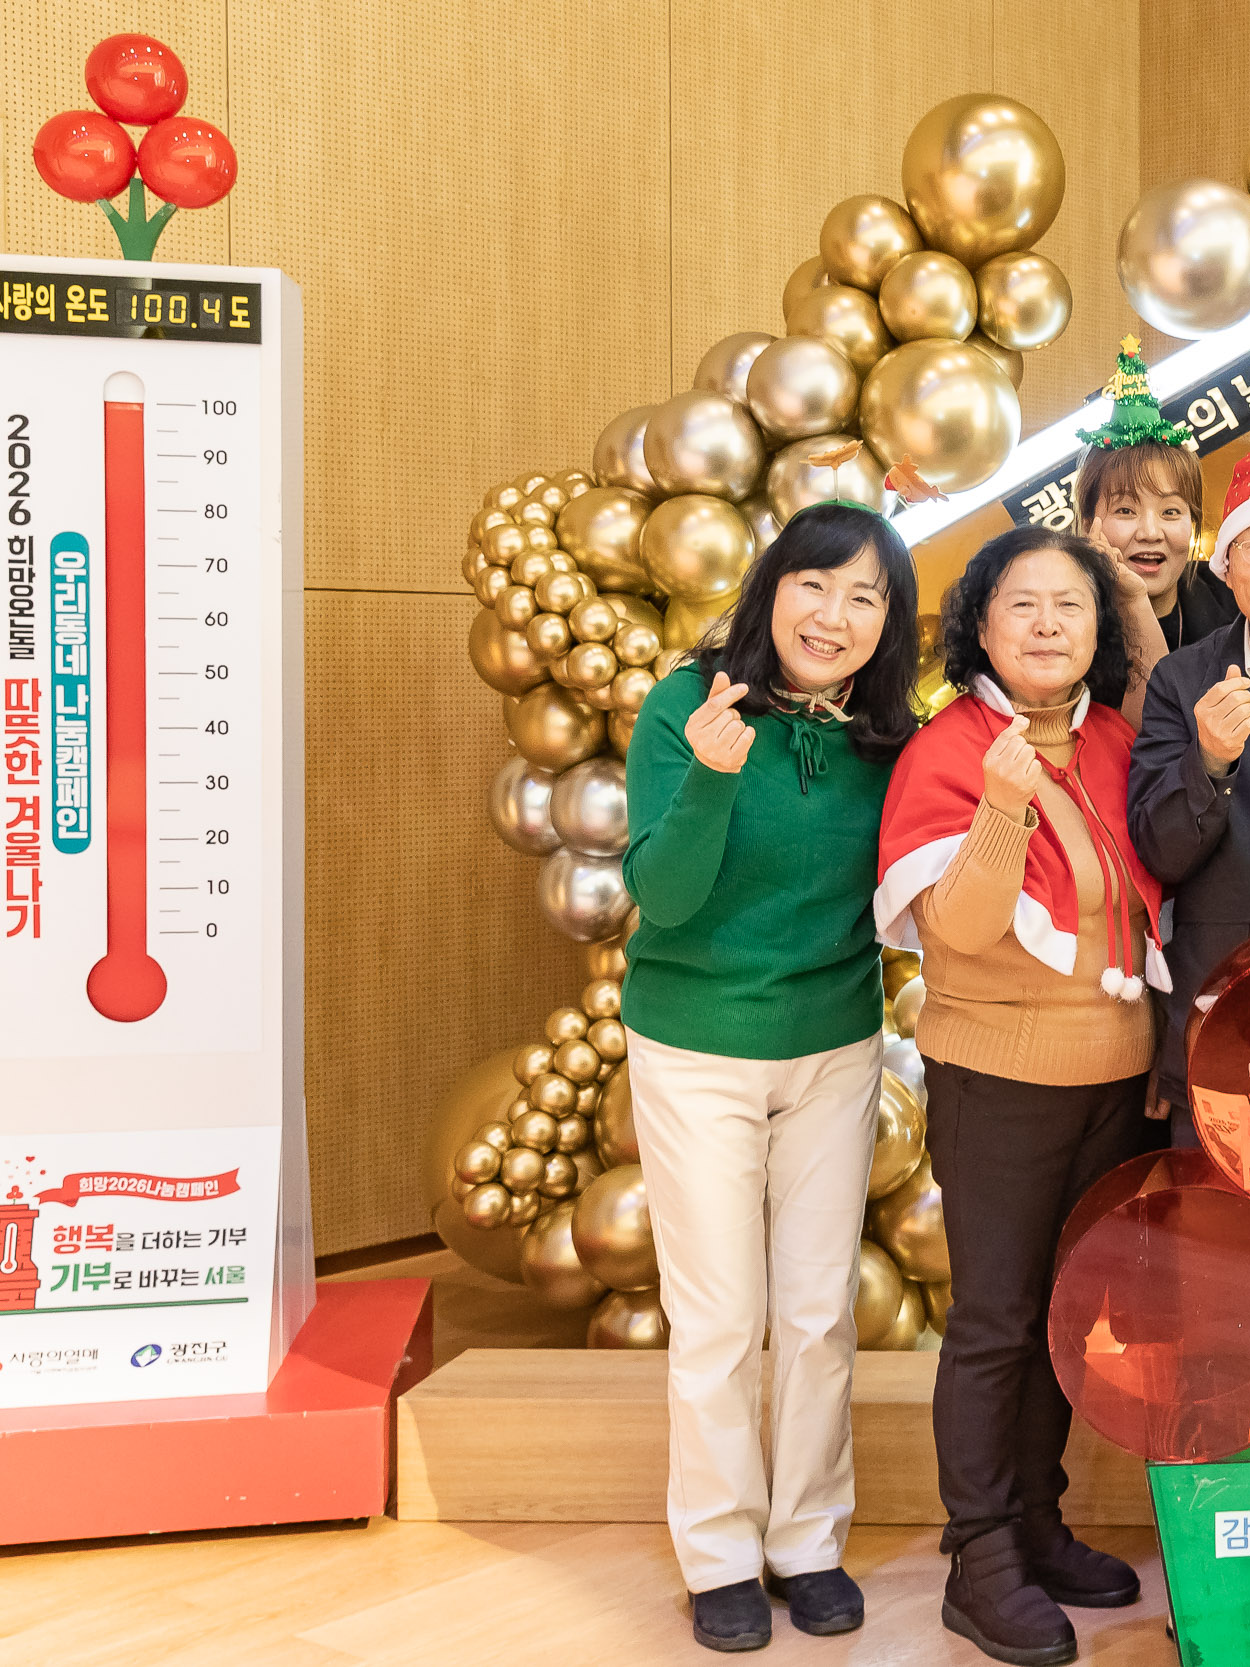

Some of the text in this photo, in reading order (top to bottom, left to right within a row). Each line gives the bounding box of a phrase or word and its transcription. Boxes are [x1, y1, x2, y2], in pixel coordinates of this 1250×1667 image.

[65, 284, 109, 323] 온도
[131, 294, 221, 329] 100.4
[229, 295, 251, 329] 도
[203, 400, 237, 416] 100
[203, 449, 228, 465] 90
[204, 503, 228, 519] 80
[205, 557, 228, 573] 70
[204, 611, 228, 627] 60
[4, 414, 43, 939] 2026 희망온돌 따뜻한 겨울나기
[204, 664, 229, 680] 50
[53, 550, 90, 839] 우리동네 나눔캠페인
[204, 720, 229, 736] 40
[205, 774, 229, 790] 30
[205, 829, 229, 845] 20
[207, 879, 230, 895] 10
[206, 922, 218, 938] 0
[79, 1176, 219, 1198] 희망2026나눔캠페인
[53, 1223, 247, 1254] 행복을 더하는 기부
[50, 1262, 245, 1292] 기부로 바꾸는 서울
[170, 1341, 227, 1357] 광진구
[10, 1348, 98, 1368] 사랑의열매
